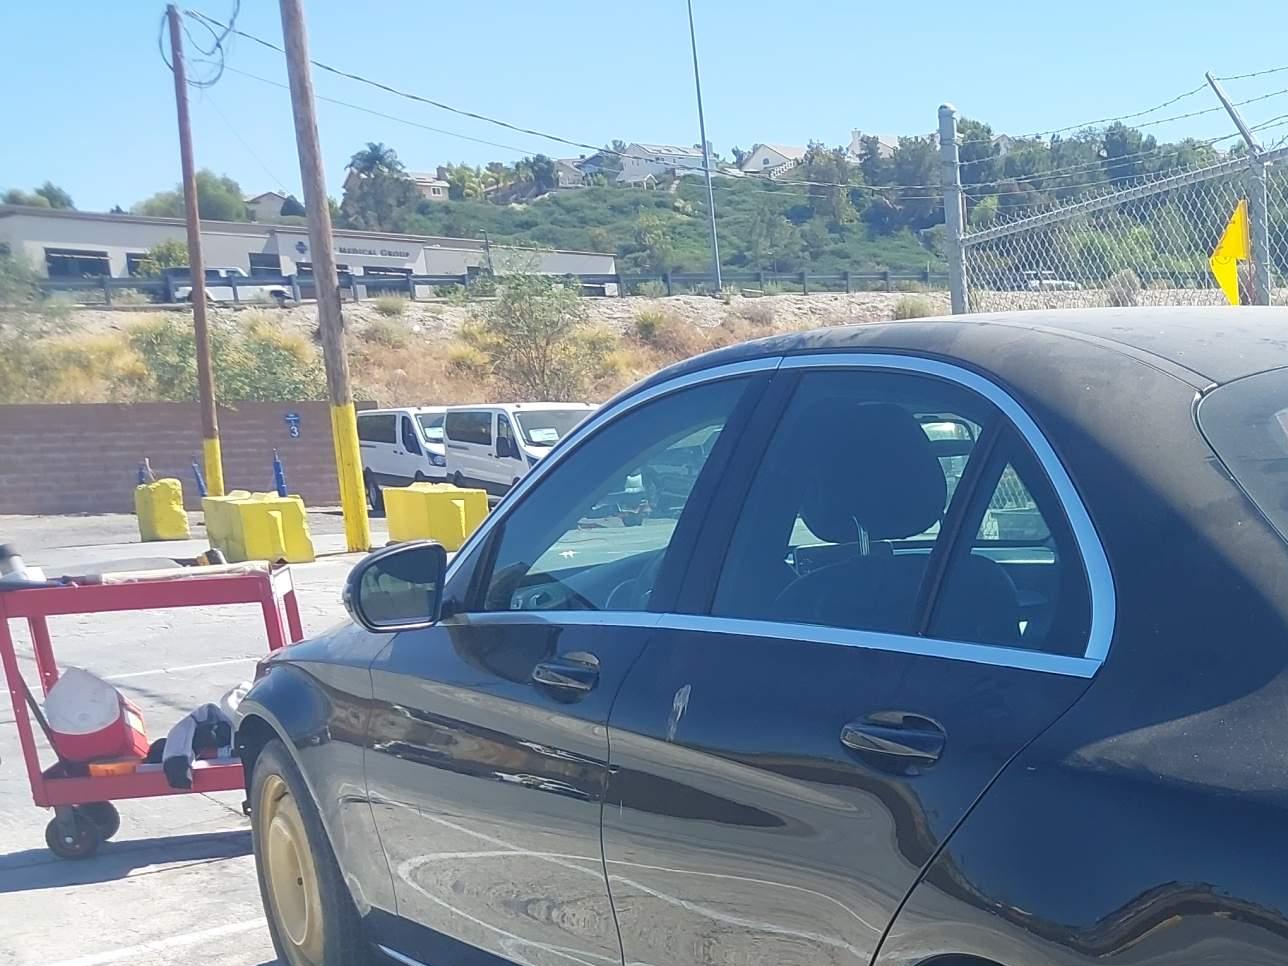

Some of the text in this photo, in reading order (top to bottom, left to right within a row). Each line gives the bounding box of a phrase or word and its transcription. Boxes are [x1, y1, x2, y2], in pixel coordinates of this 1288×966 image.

[339, 247, 410, 257] MEDICAL GROUP
[290, 426, 299, 437] 3
